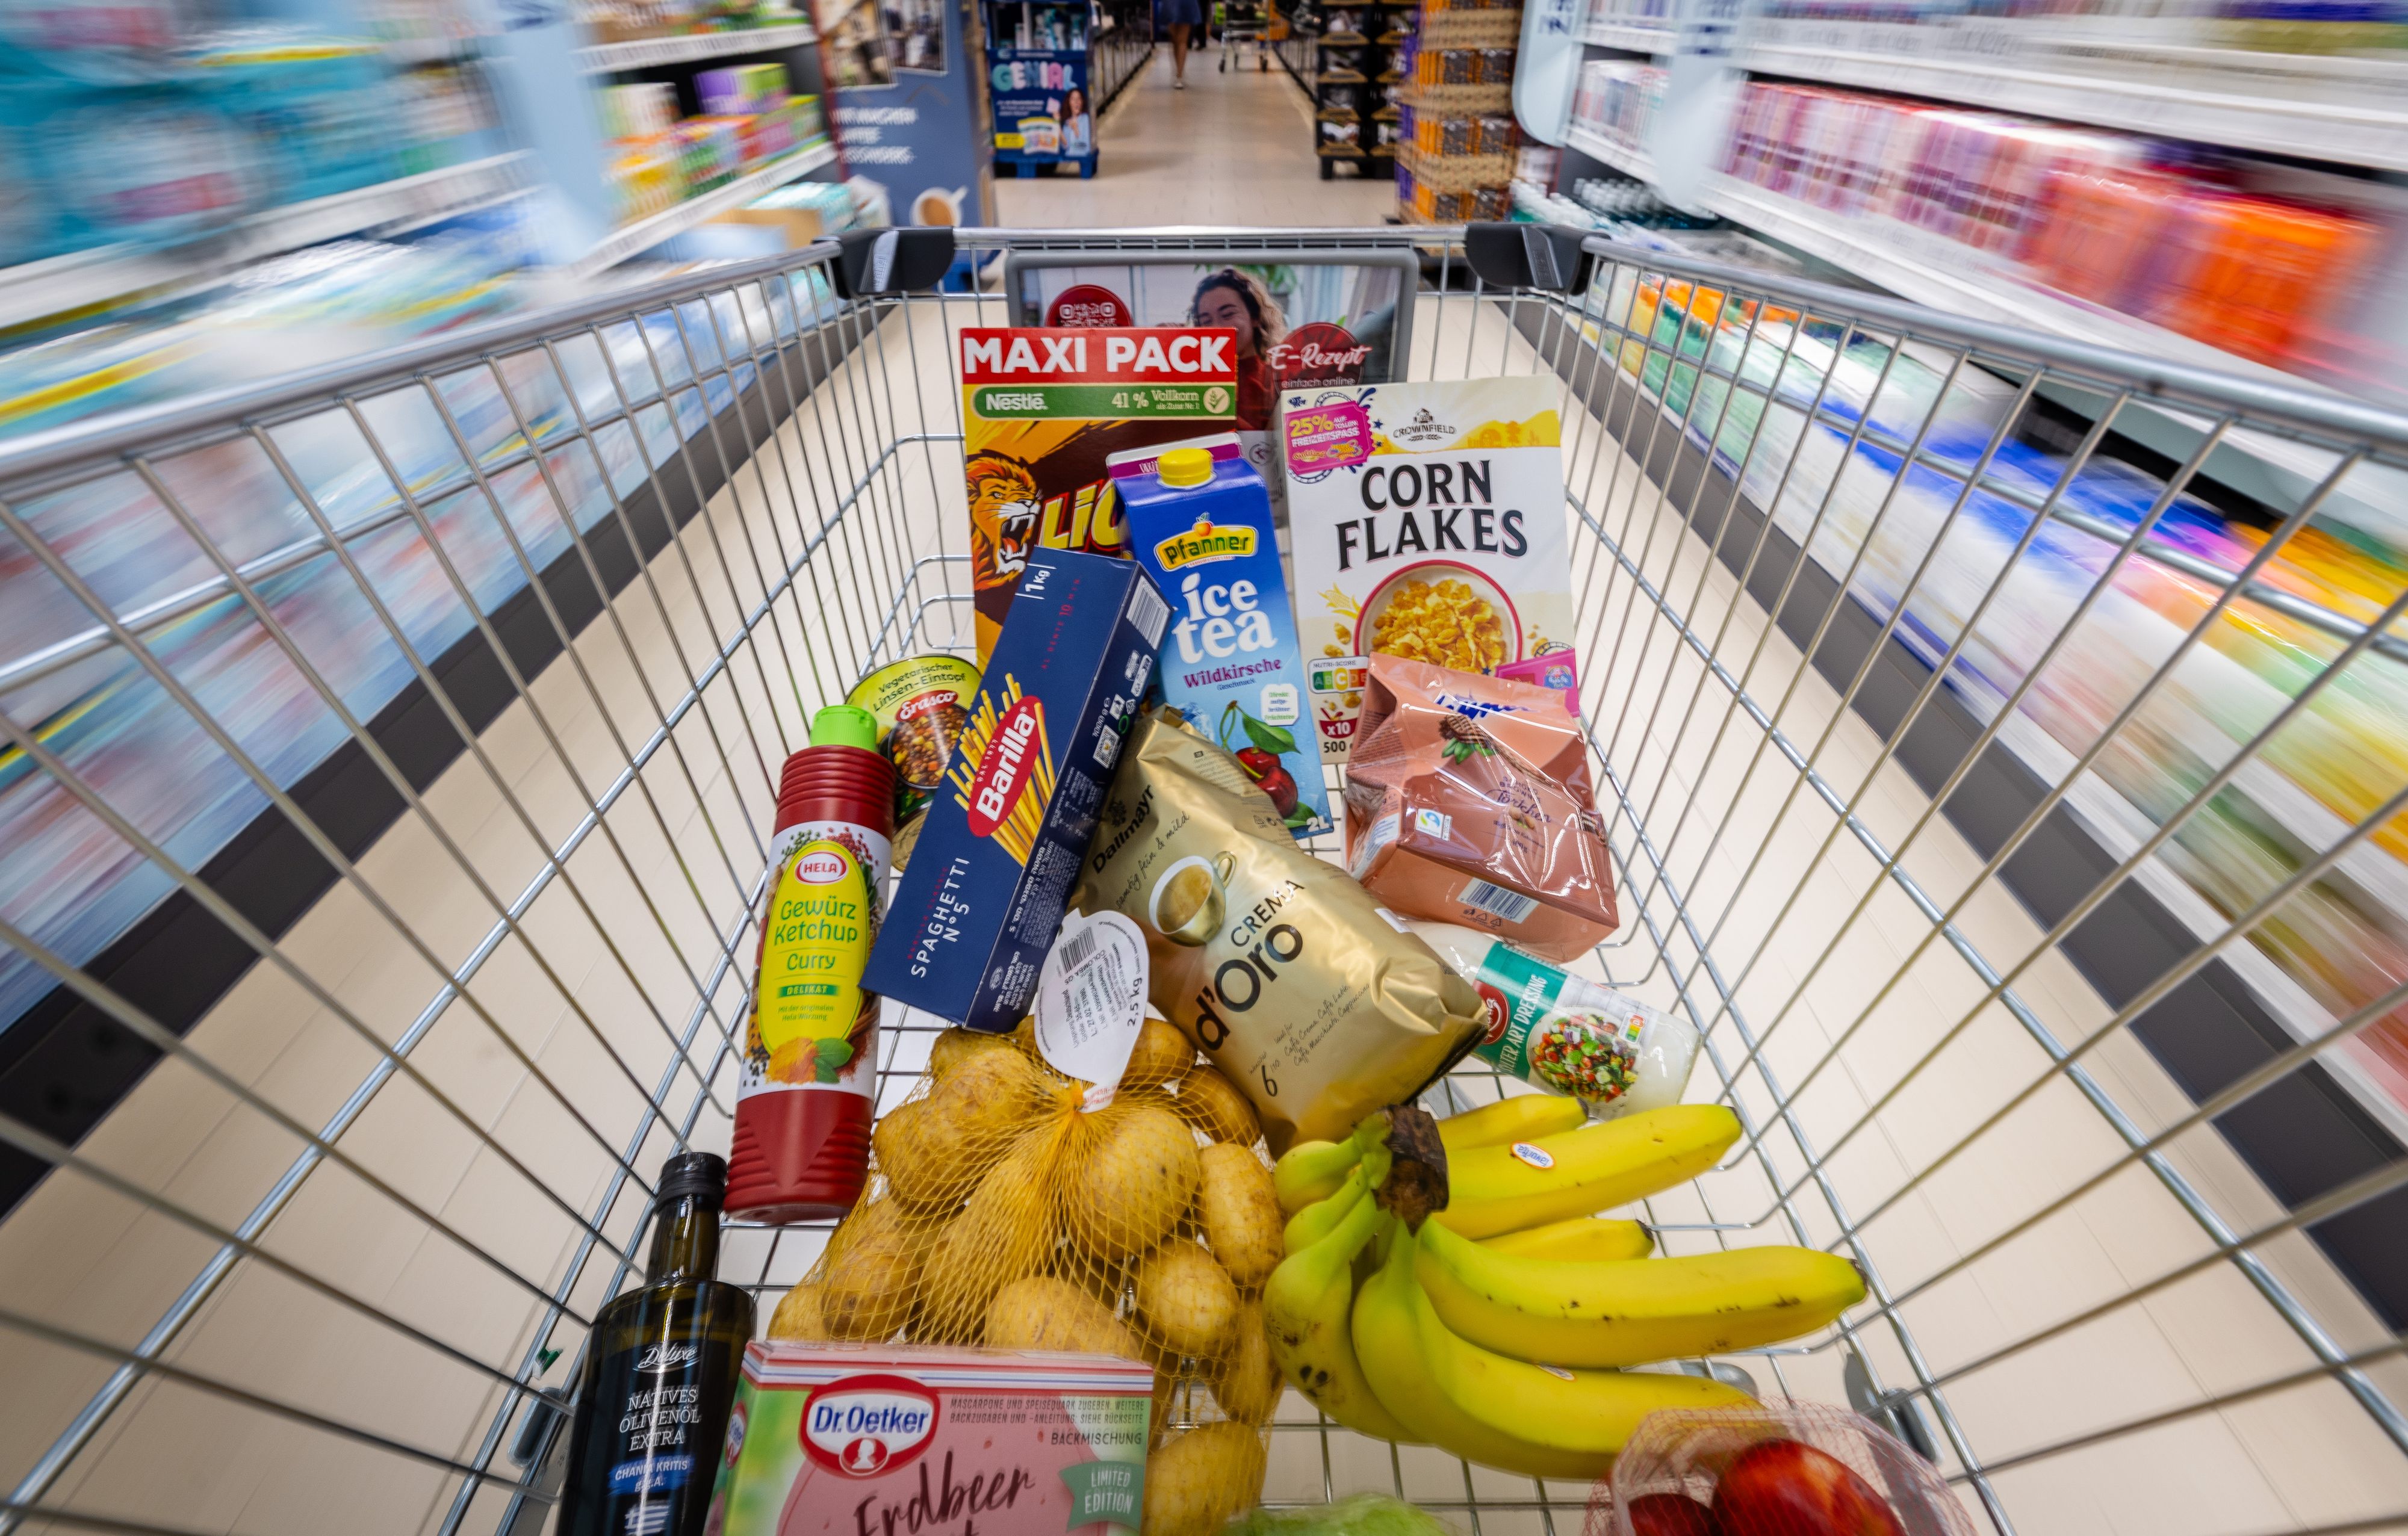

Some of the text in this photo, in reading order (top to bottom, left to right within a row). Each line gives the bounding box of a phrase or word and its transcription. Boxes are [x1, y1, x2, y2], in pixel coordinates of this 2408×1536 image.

[992, 61, 1078, 91] GENIAL
[964, 335, 1232, 374] MAXI PACK
[1266, 342, 1373, 372] E-Rezept
[1151, 389, 1199, 401] Vollkorn
[1282, 377, 1355, 389] einfach online
[986, 393, 1045, 410] Nestlé
[1111, 392, 1149, 408] 41 %
[1289, 414, 1334, 438] 25%
[1291, 427, 1360, 447] FREIZEITSPASS
[1392, 424, 1457, 439] CROWNFIELD
[1361, 459, 1492, 512] CORN
[1041, 480, 1121, 549] LiO
[1163, 536, 1251, 564] Pfanner
[1335, 508, 1527, 572] FLAKES
[1182, 572, 1258, 622] ice
[1060, 604, 1073, 617] 10
[1171, 610, 1278, 664] tea
[879, 664, 954, 693] Vegetarischer
[1183, 658, 1282, 689] Wildkirsche
[1217, 678, 1256, 690] Geschmack
[1315, 677, 1323, 686] A
[1326, 677, 1332, 685] B
[1336, 672, 1347, 685] C
[874, 674, 966, 712] Linsen-Eintopf
[900, 692, 954, 719] Erasco
[1327, 722, 1351, 735] x10
[1324, 740, 1346, 753] 500
[976, 713, 1035, 822] Barilla
[1092, 785, 1155, 873] Dallmayr
[1167, 811, 1190, 841] mild
[1306, 816, 1330, 829] 2L
[804, 862, 837, 873] HELA
[781, 896, 857, 921] Gewürz
[911, 858, 970, 978] SPAGHETTI
[1230, 879, 1305, 947] CREMA
[774, 920, 858, 946] Ketchup
[787, 953, 836, 971] Curry
[1074, 949, 1105, 979] COLOMBA
[787, 985, 828, 996] DELIKAT
[1195, 924, 1303, 1051] d'Oro
[1127, 977, 1143, 1027] 2,5 kg
[1510, 1022, 1527, 1048] ART
[1519, 974, 1548, 1025] DRESSING
[1261, 1065, 1277, 1097] 6
[638, 1343, 701, 1369] Deluxe
[627, 1387, 698, 1411] NATIVES
[950, 1398, 1004, 1410] MASCARPONE
[1007, 1399, 1022, 1410] UND
[1025, 1399, 1075, 1411] SPEISEQUARK
[1115, 1400, 1144, 1411] WEITERE
[619, 1406, 700, 1433] OLIVENÖL
[950, 1412, 1007, 1423] BACKZUGABEN
[1010, 1413, 1026, 1423] UND
[1080, 1413, 1101, 1424] SIEHE
[1104, 1412, 1143, 1424] RÜCKSEITE
[629, 1428, 685, 1452] EXTRA
[1051, 1431, 1142, 1445] BACKMISCHUNG
[615, 1458, 690, 1481] CHANIA KRITIS
[1090, 1469, 1131, 1487] LIMITED
[853, 1451, 1035, 1536] Erdbeer
[1084, 1492, 1134, 1514] EDITION
